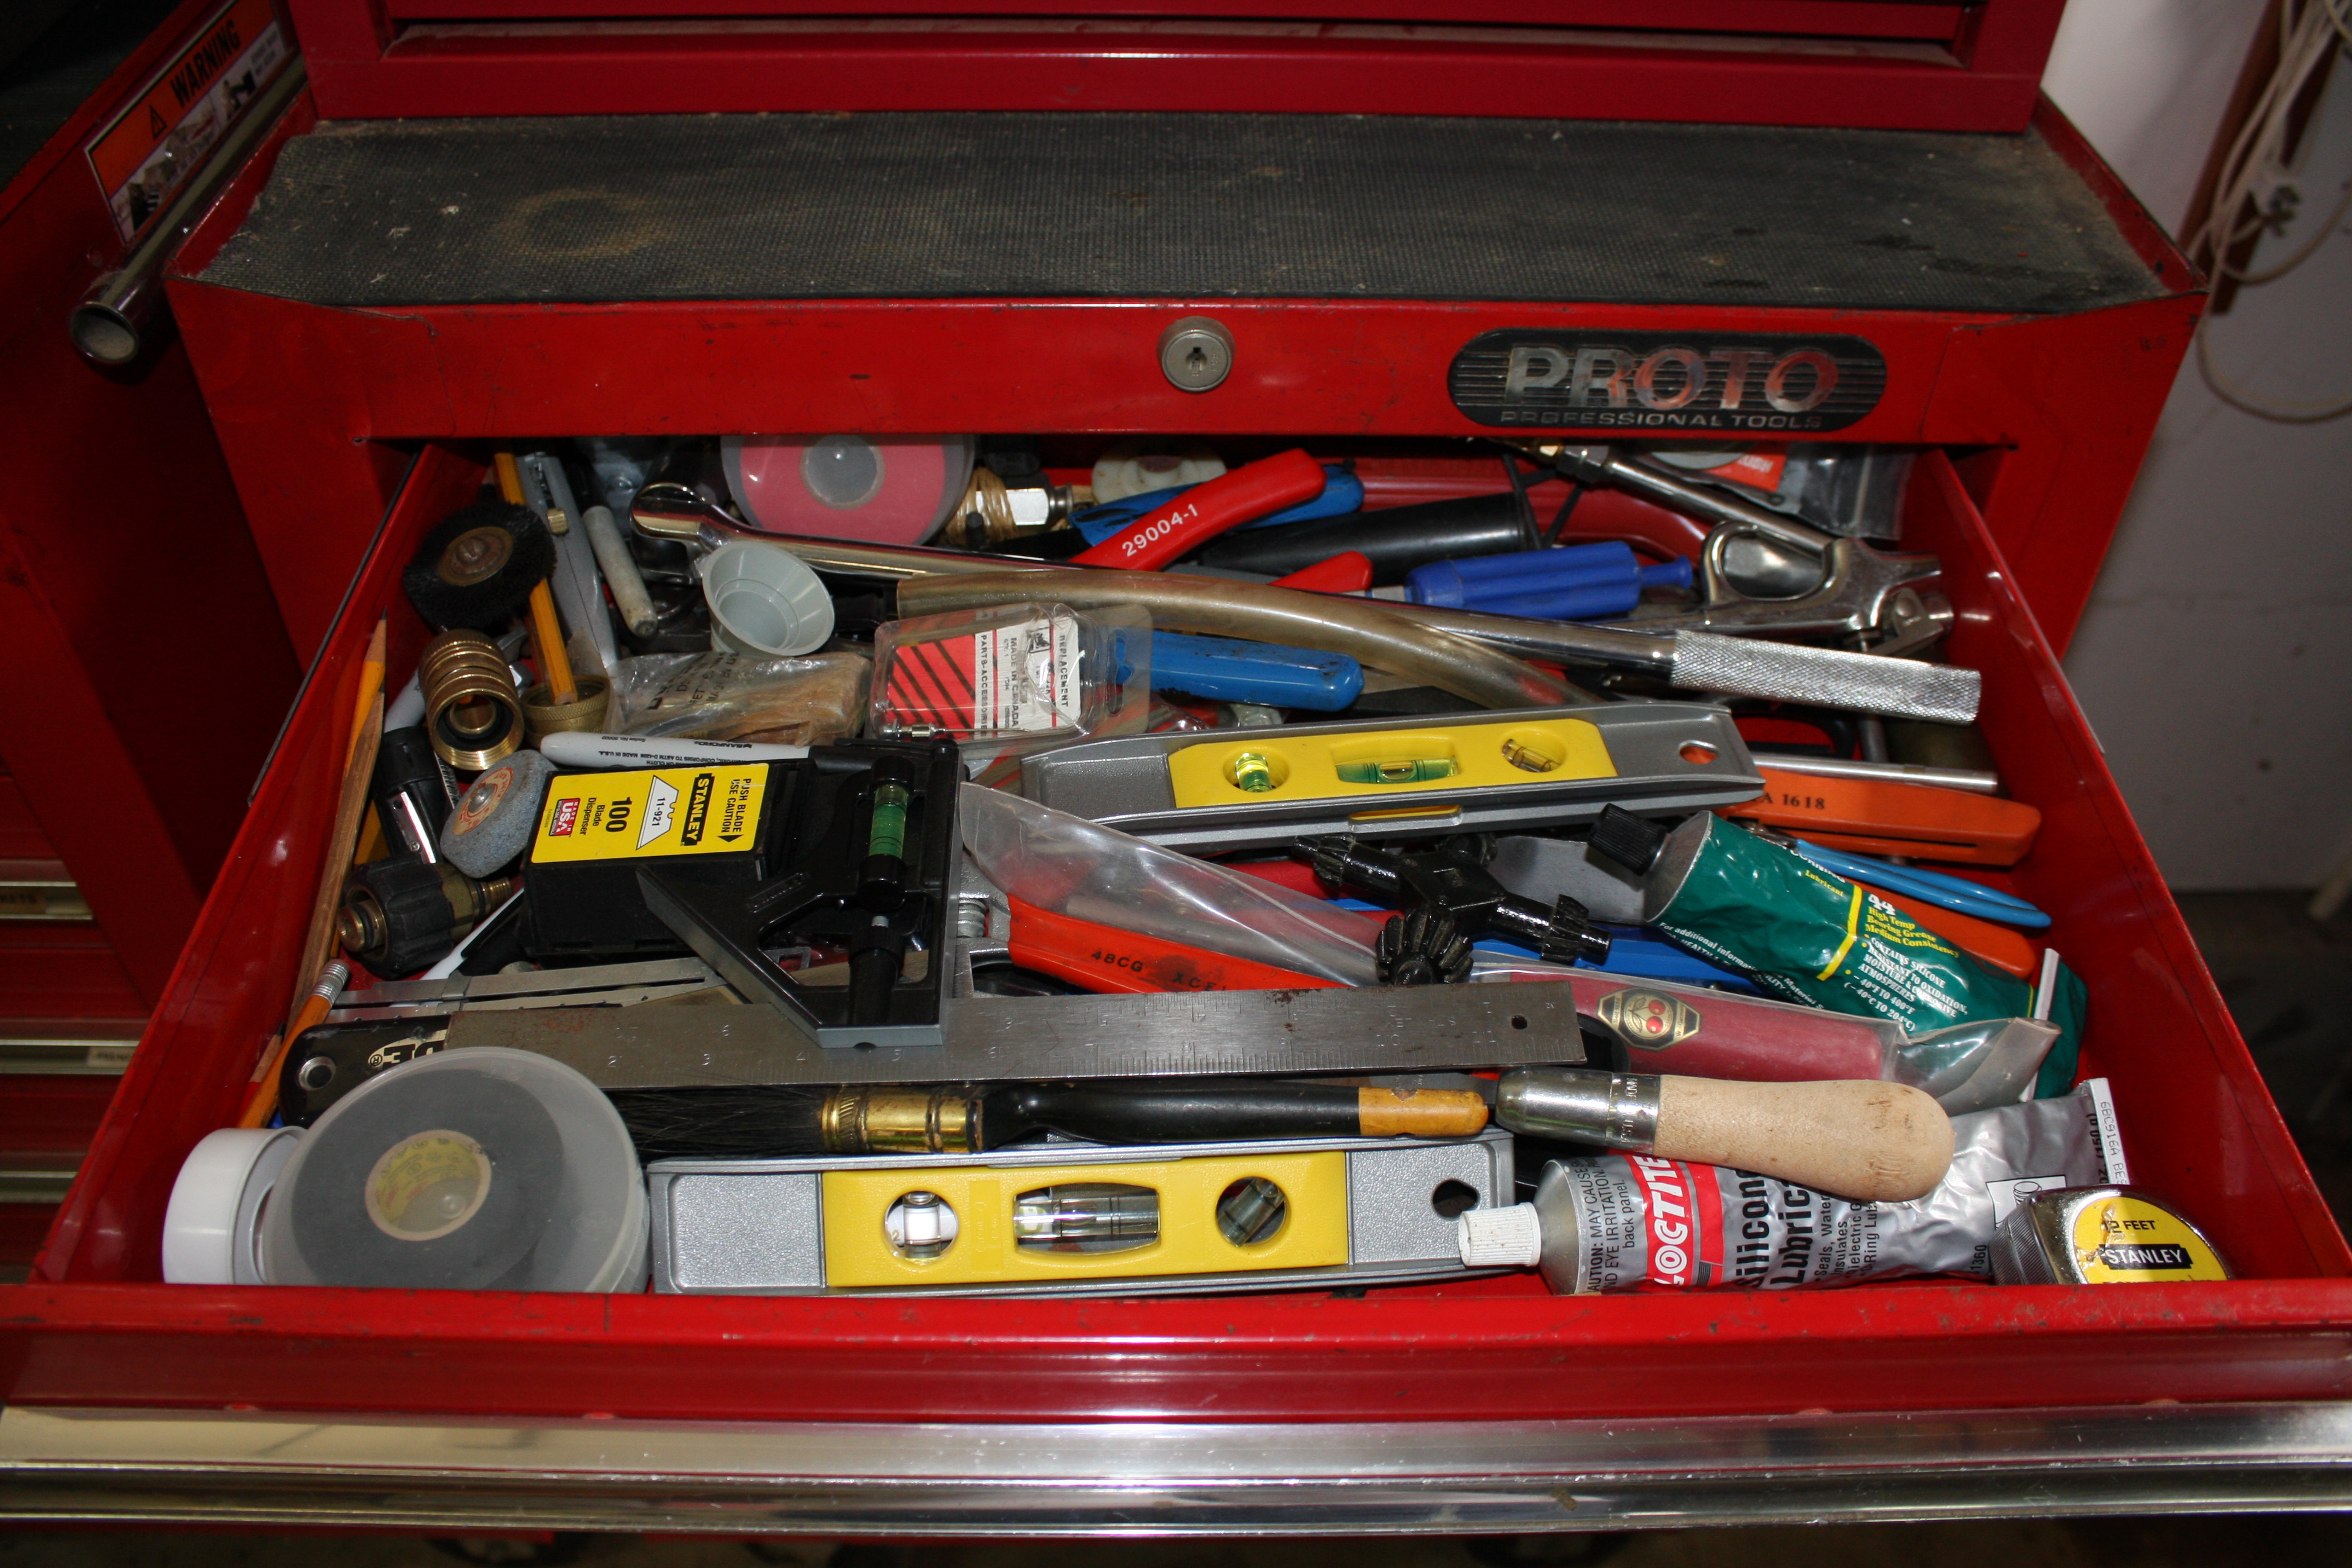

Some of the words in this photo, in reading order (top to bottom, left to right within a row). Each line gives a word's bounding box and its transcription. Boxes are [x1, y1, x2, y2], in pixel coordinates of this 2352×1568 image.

[169, 19, 241, 108] WARNING
[1504, 347, 1839, 413] PROTO
[1500, 411, 1723, 427] PROFESSIONAL
[1730, 415, 1822, 430] TOOLS
[1122, 503, 1198, 558] 29004-1
[1011, 670, 1018, 681] IN
[1059, 635, 1069, 707] REPLACEMENT
[729, 779, 740, 795] USE
[739, 778, 751, 801] PUSH
[1782, 794, 1826, 809] 1618
[556, 802, 574, 833] USA
[580, 797, 597, 835] Dispenser
[592, 805, 606, 826] Blade
[606, 797, 632, 832] 100
[652, 797, 666, 826] 11-921
[686, 778, 710, 841] STANLEY
[721, 797, 736, 833] CAUTION
[733, 804, 746, 832] BLADE
[1805, 869, 1844, 897] Lubricant
[1867, 893, 1896, 916] 44
[1867, 906, 1888, 924] High
[1890, 915, 1915, 930] Temp
[1659, 922, 1674, 931] For
[1674, 927, 1719, 950] additional
[1864, 924, 1901, 944] Medium
[1903, 938, 1960, 958] Consistency
[1866, 914, 1902, 937] Bearing
[1903, 926, 1937, 942] Grease
[1870, 937, 1910, 965] CONTAINS
[1910, 961, 1947, 988] SILICONE
[1858, 963, 1916, 1003] ATMOSPHERES
[1863, 954, 1907, 985] MOISTURE
[1905, 981, 1912, 990] &
[1912, 986, 1958, 1018] CORROSIVE
[1910, 973, 1921, 985] TO
[1920, 981, 1968, 1015] OXIDATION,
[1875, 1000, 1889, 1013] TO
[1887, 1009, 1916, 1032] 204°C)
[1878, 988, 1891, 1001] TO
[1890, 995, 1916, 1016] 400°F
[1575, 1168, 1598, 1204] CAUSE
[1613, 1180, 1635, 1214] panel.
[1592, 1171, 1619, 1241] IRRITATION.
[1632, 1155, 1688, 1286] LOCTITE
[1820, 1190, 1833, 1238] Water
[1864, 1203, 1878, 1229] Lub
[1588, 1209, 1603, 1238] MAY
[1622, 1217, 1635, 1248] back
[1734, 1169, 1770, 1288] Silicon
[1769, 1180, 1814, 1284] Lubric
[2103, 1220, 2123, 1233] 12
[2123, 1220, 2155, 1230] FEET
[1604, 1245, 1619, 1268] EYE
[1815, 1241, 1835, 1277] Seals,
[1830, 1221, 1848, 1276] Insulates
[1846, 1215, 1863, 1278] Dielectric
[1969, 1244, 1987, 1272] 1360
[2105, 1249, 2182, 1264] STANLEY
[1586, 1243, 1604, 1292] AUTION:
[1602, 1272, 1618, 1289] ND
